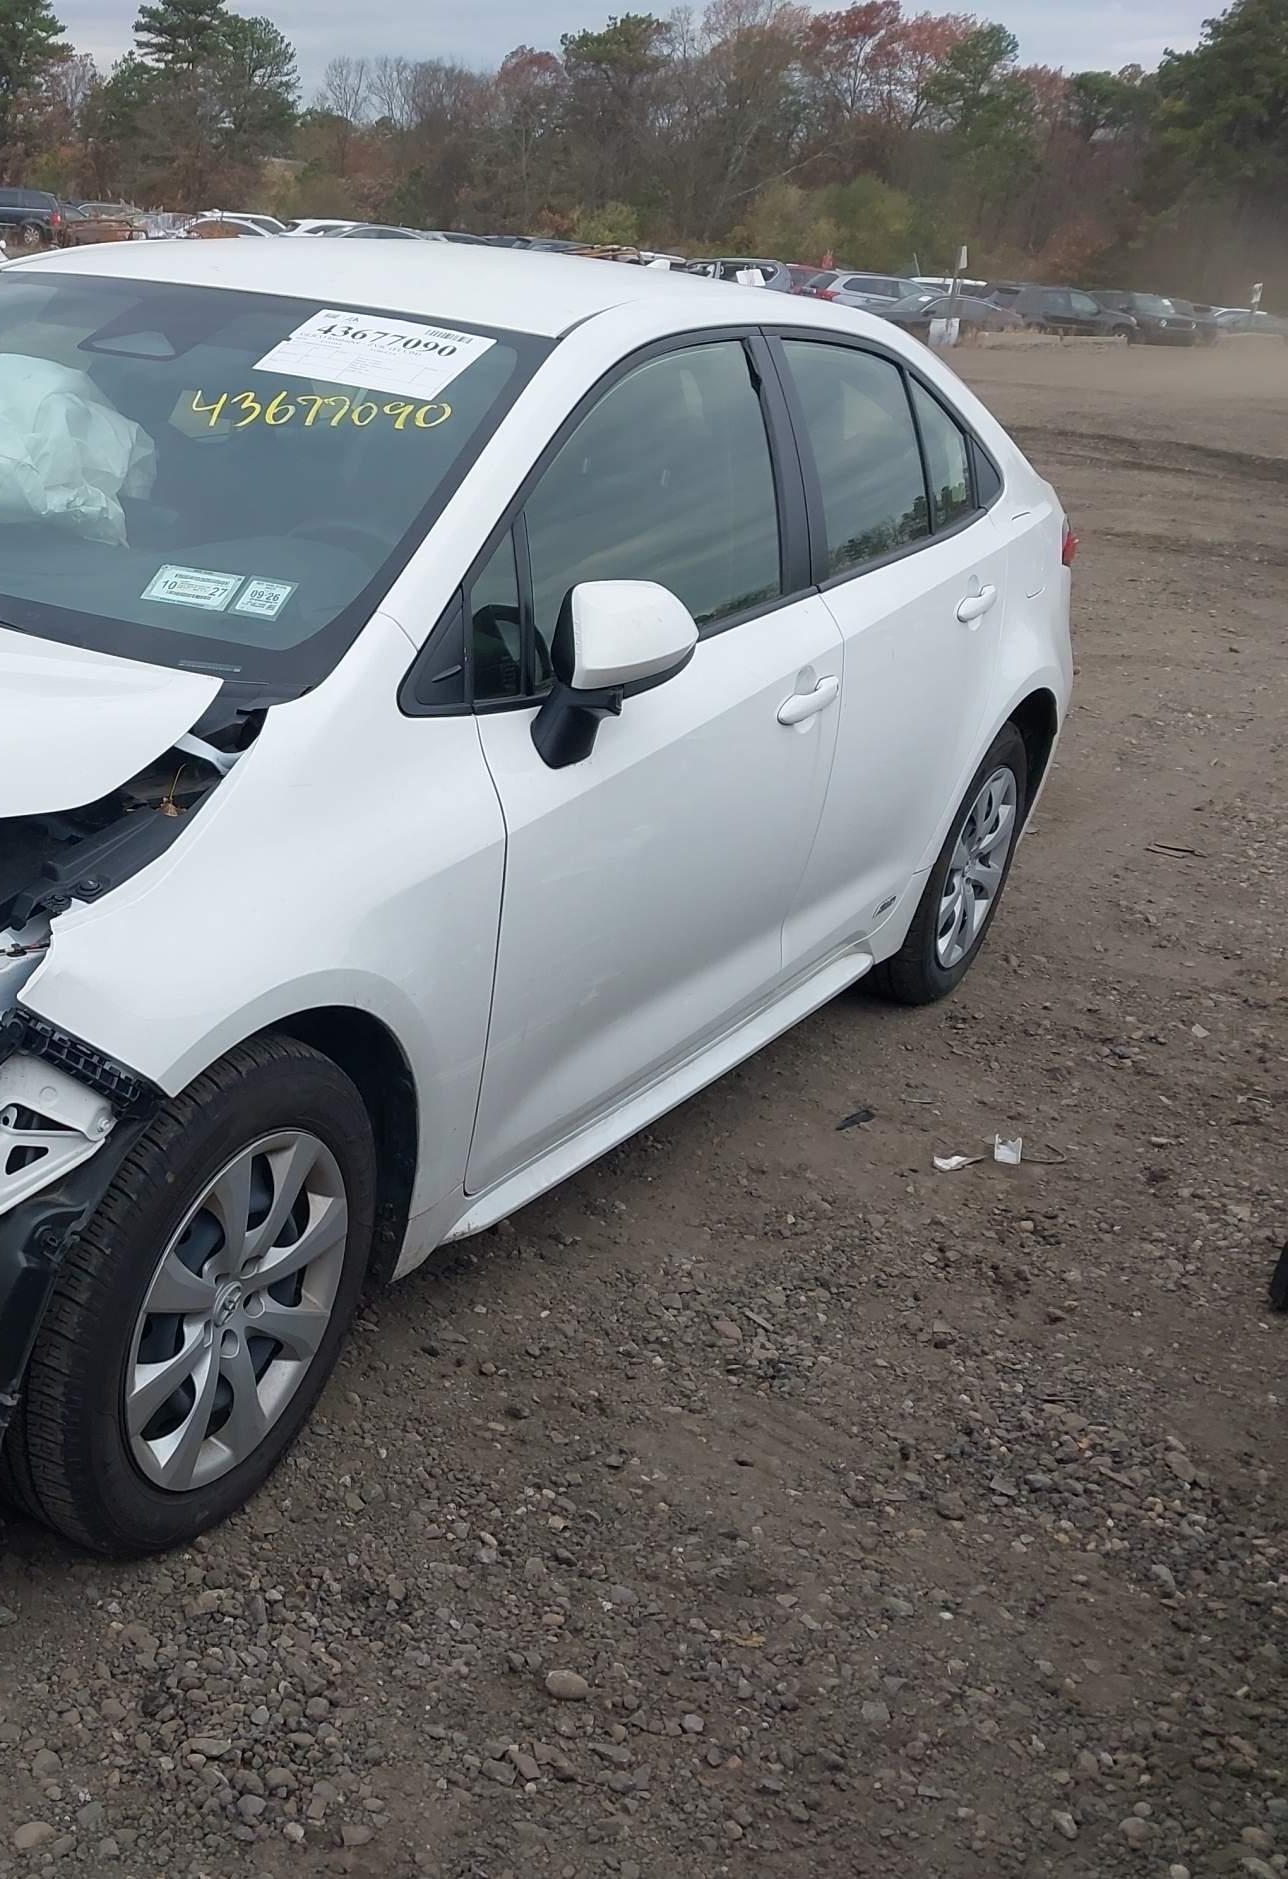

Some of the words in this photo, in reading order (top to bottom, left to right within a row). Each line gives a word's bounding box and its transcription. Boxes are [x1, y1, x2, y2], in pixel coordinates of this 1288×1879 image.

[316, 322, 458, 358] 43677090
[191, 388, 452, 430] 43677090
[162, 579, 178, 590] 10
[208, 586, 229, 599] 27
